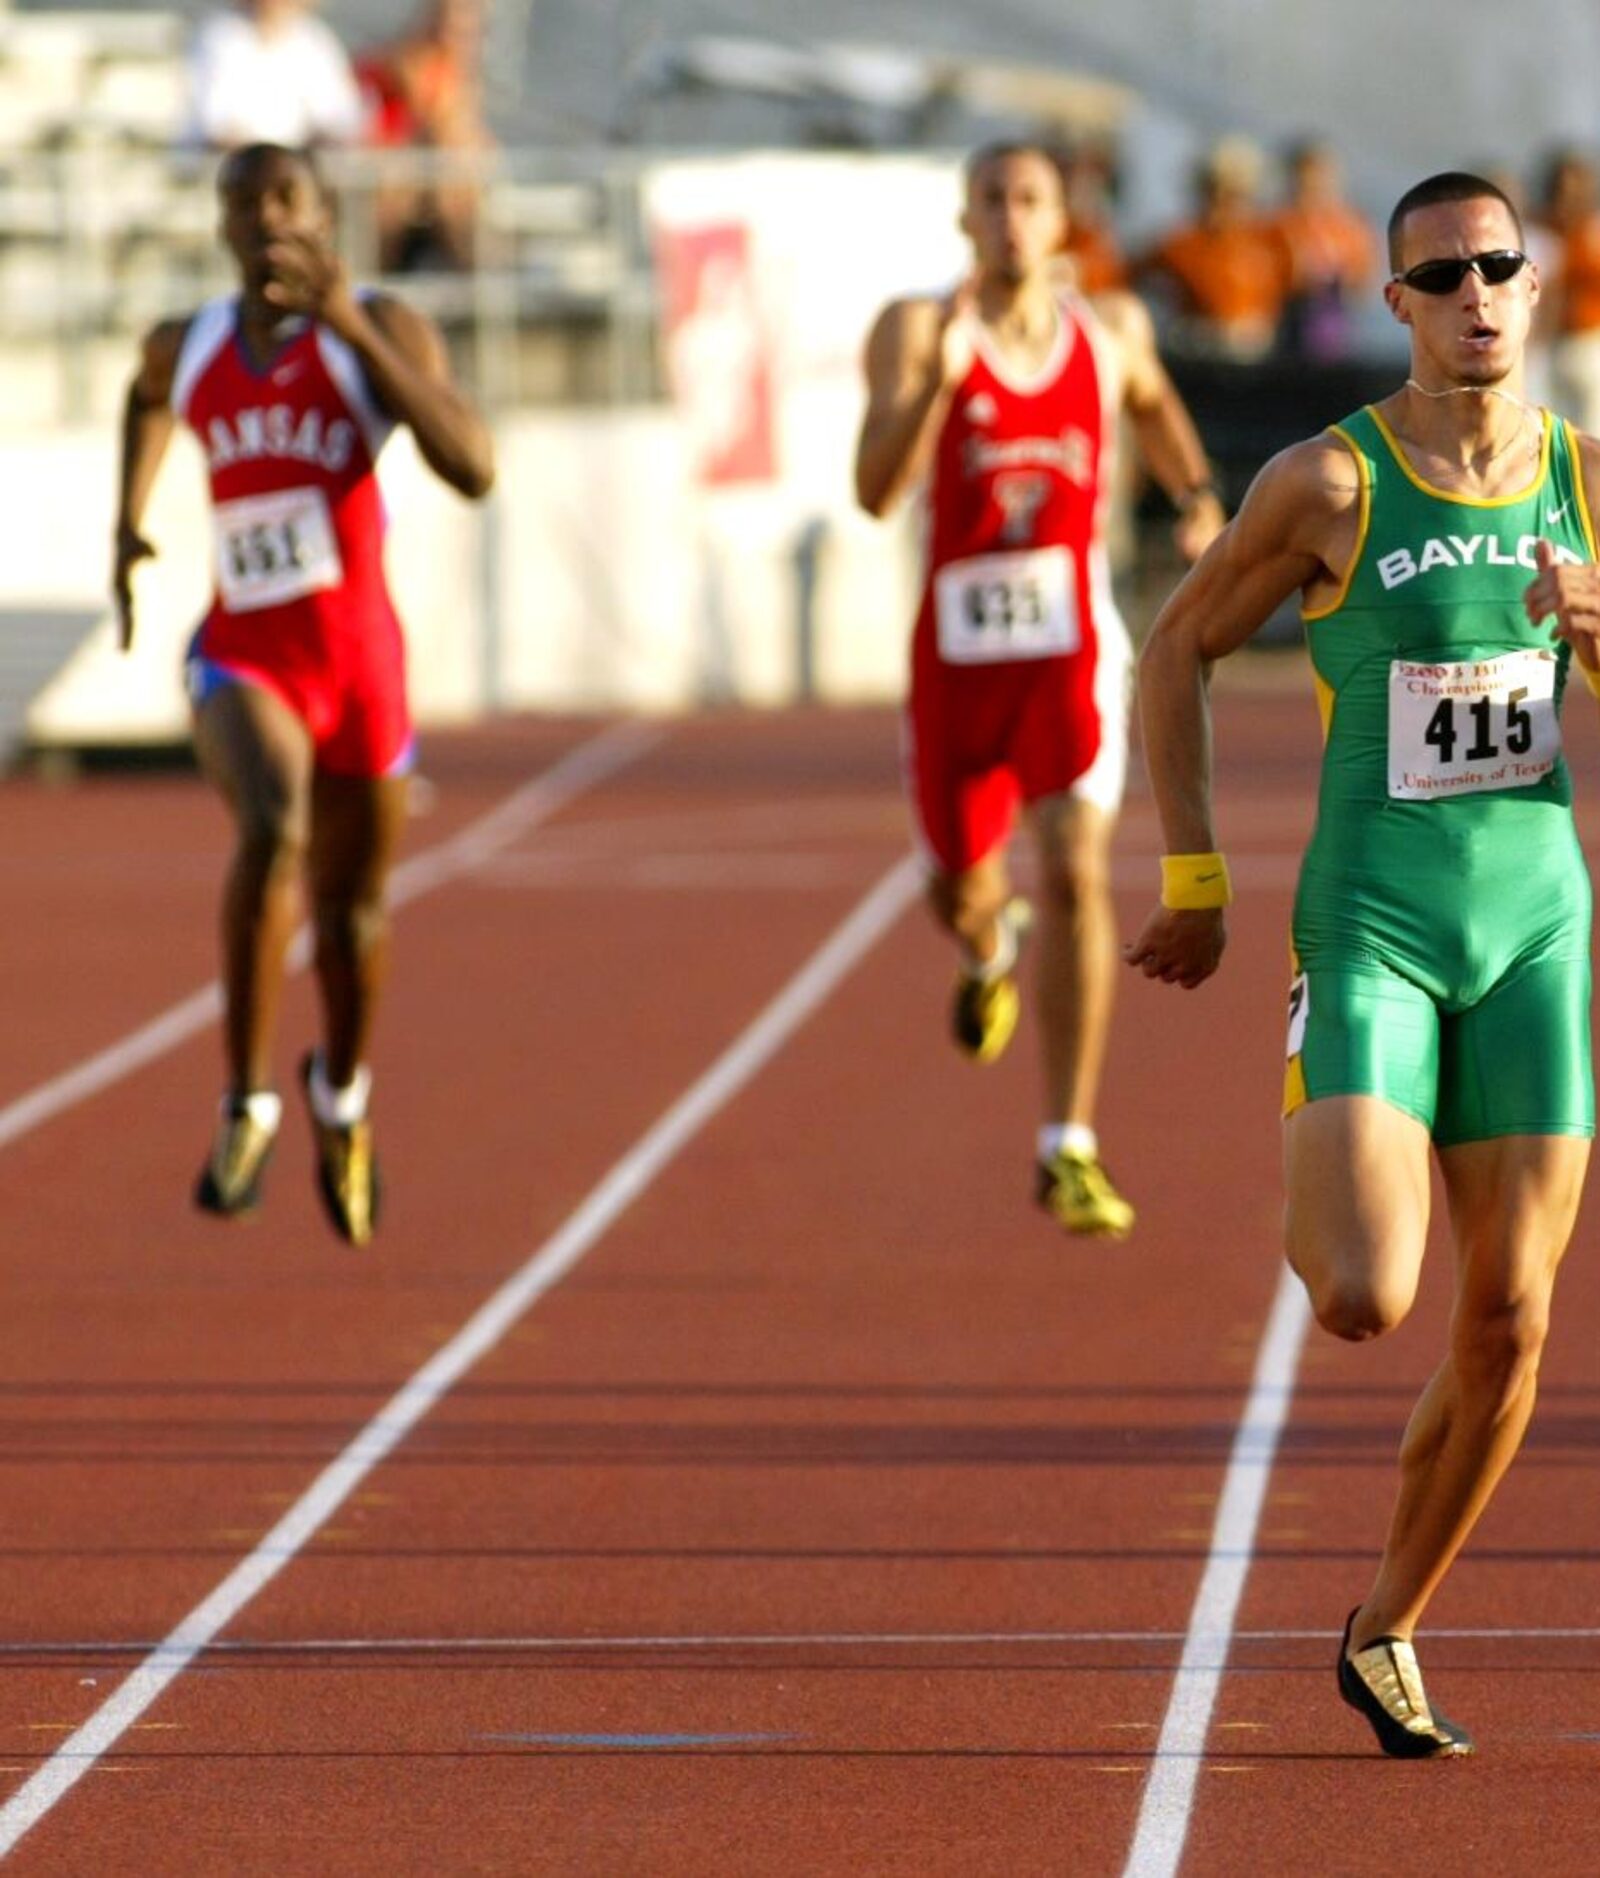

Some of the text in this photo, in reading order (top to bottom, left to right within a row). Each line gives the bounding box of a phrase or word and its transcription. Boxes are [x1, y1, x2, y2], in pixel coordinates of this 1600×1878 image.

[1425, 686, 1532, 763] 415
[1403, 771, 1484, 790] University
[1490, 767, 1507, 781] of
